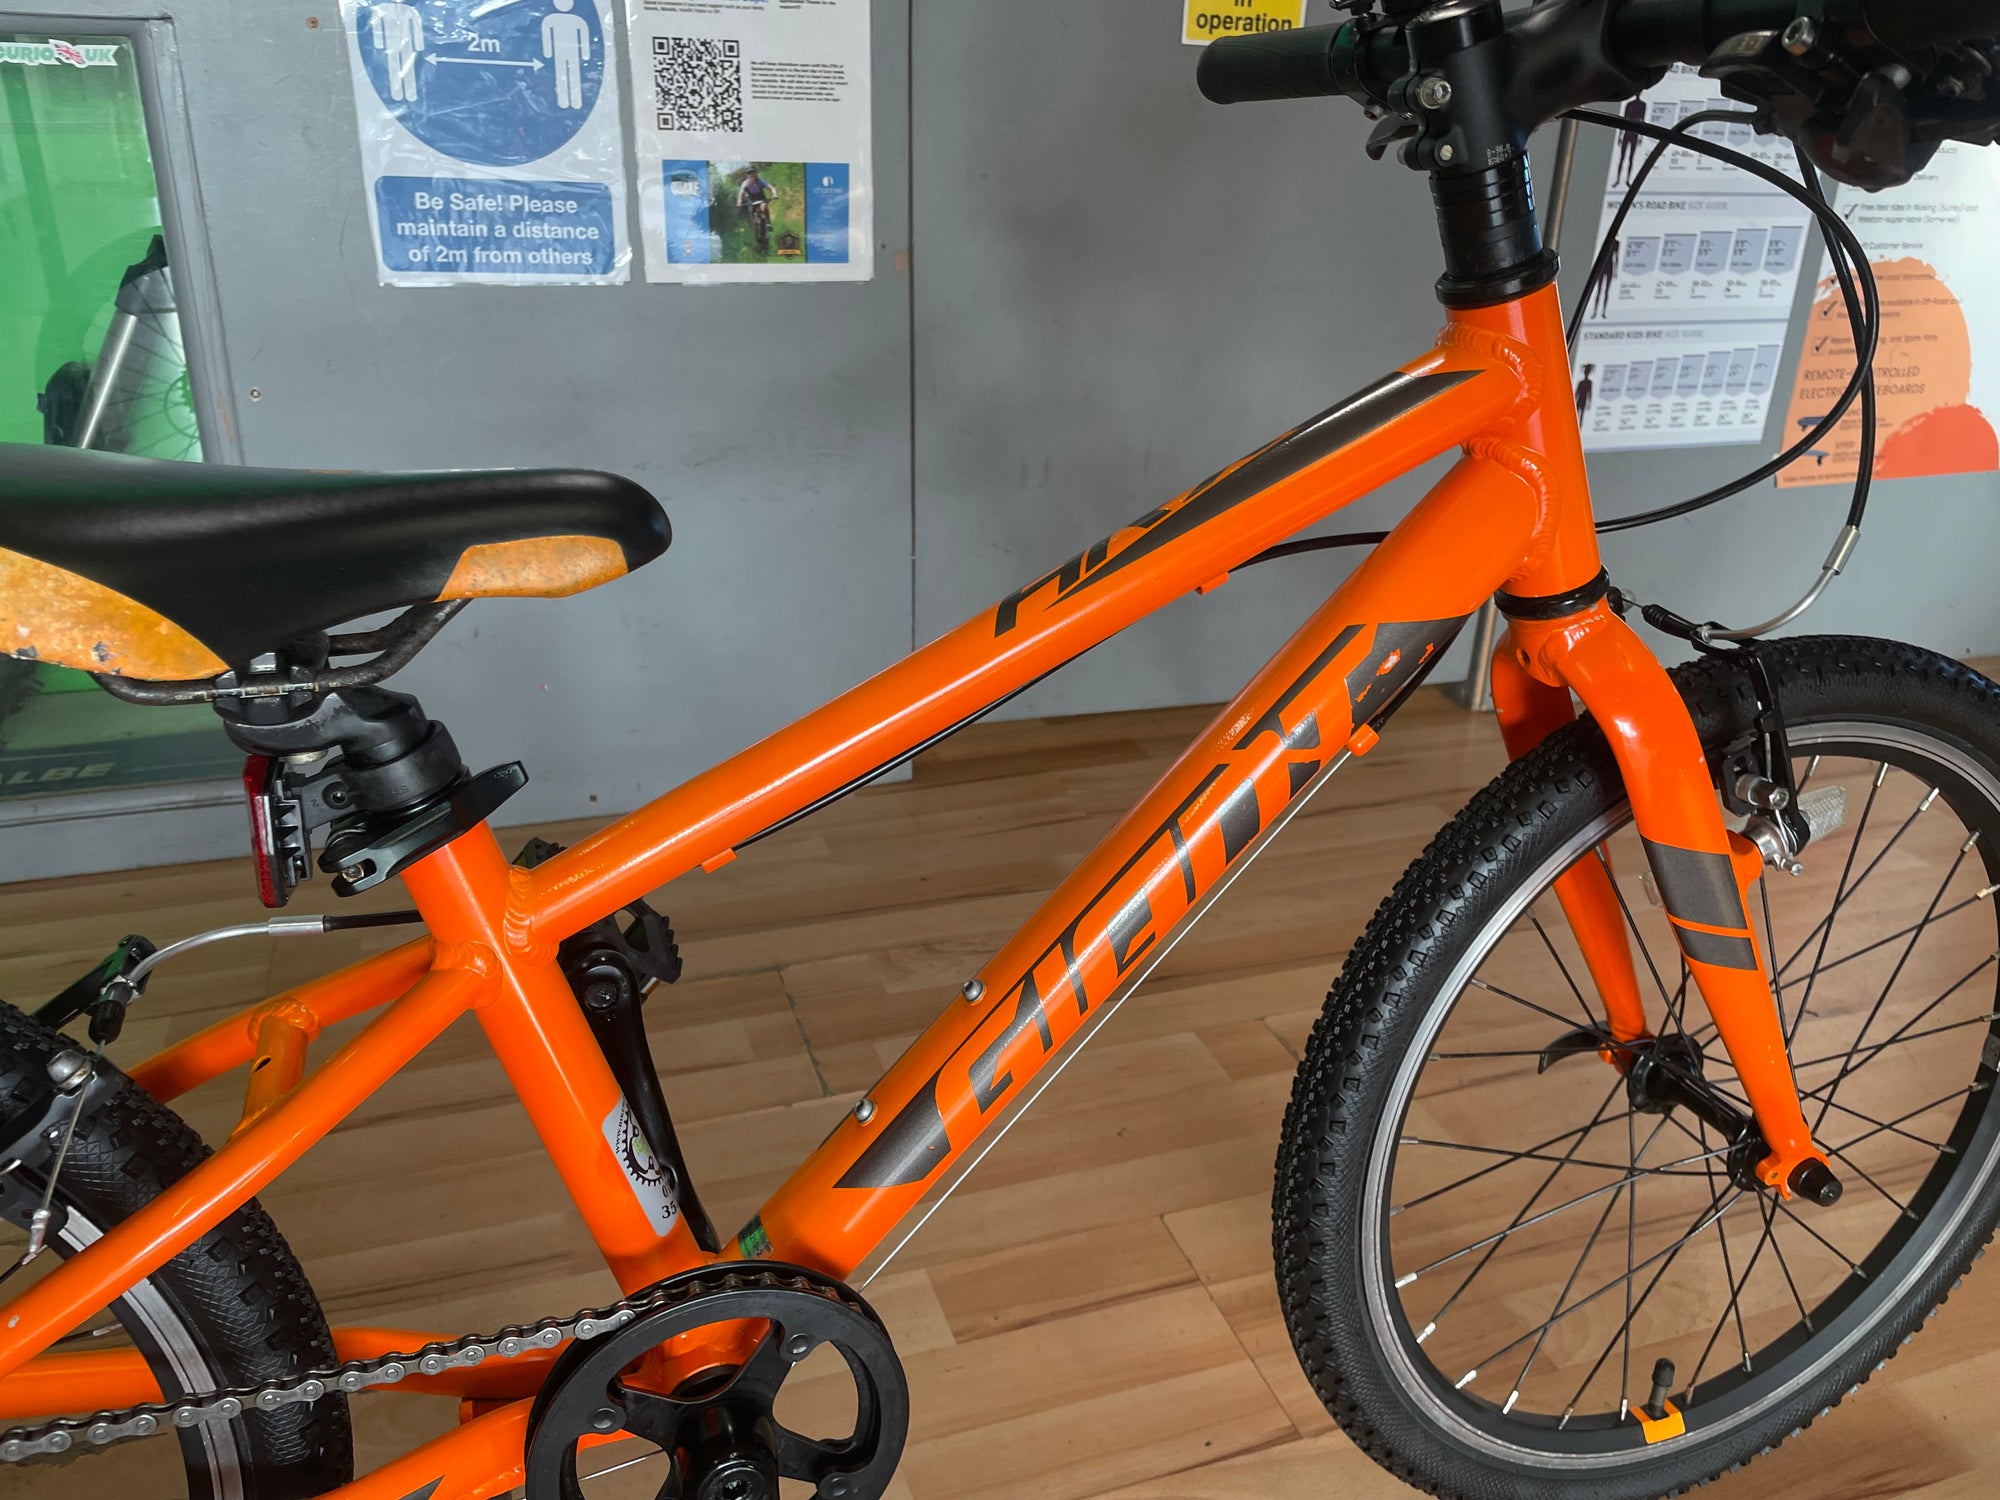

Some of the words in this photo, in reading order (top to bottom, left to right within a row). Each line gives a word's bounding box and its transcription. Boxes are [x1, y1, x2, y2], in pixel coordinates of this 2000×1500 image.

[1196, 12, 1292, 34] operation
[467, 35, 501, 53] 2m
[85, 48, 112, 62] UK
[414, 191, 443, 211] Be
[450, 193, 503, 212] Safe!
[509, 195, 578, 214] Please
[1607, 201, 1645, 210] WON'S
[1646, 201, 1667, 210] ROAD
[1668, 201, 1687, 210] BIKE
[396, 219, 488, 238] maintain
[494, 225, 507, 238] a
[513, 222, 600, 240] distance
[408, 245, 430, 263] of
[436, 245, 467, 264] 2m
[474, 245, 522, 264] from
[527, 246, 592, 266] others
[1584, 331, 1625, 341] STANDARD
[1799, 386, 1843, 400] ELECTRI
[0, 762, 116, 785] LBE
[920, 620, 1385, 1180] GIANT
